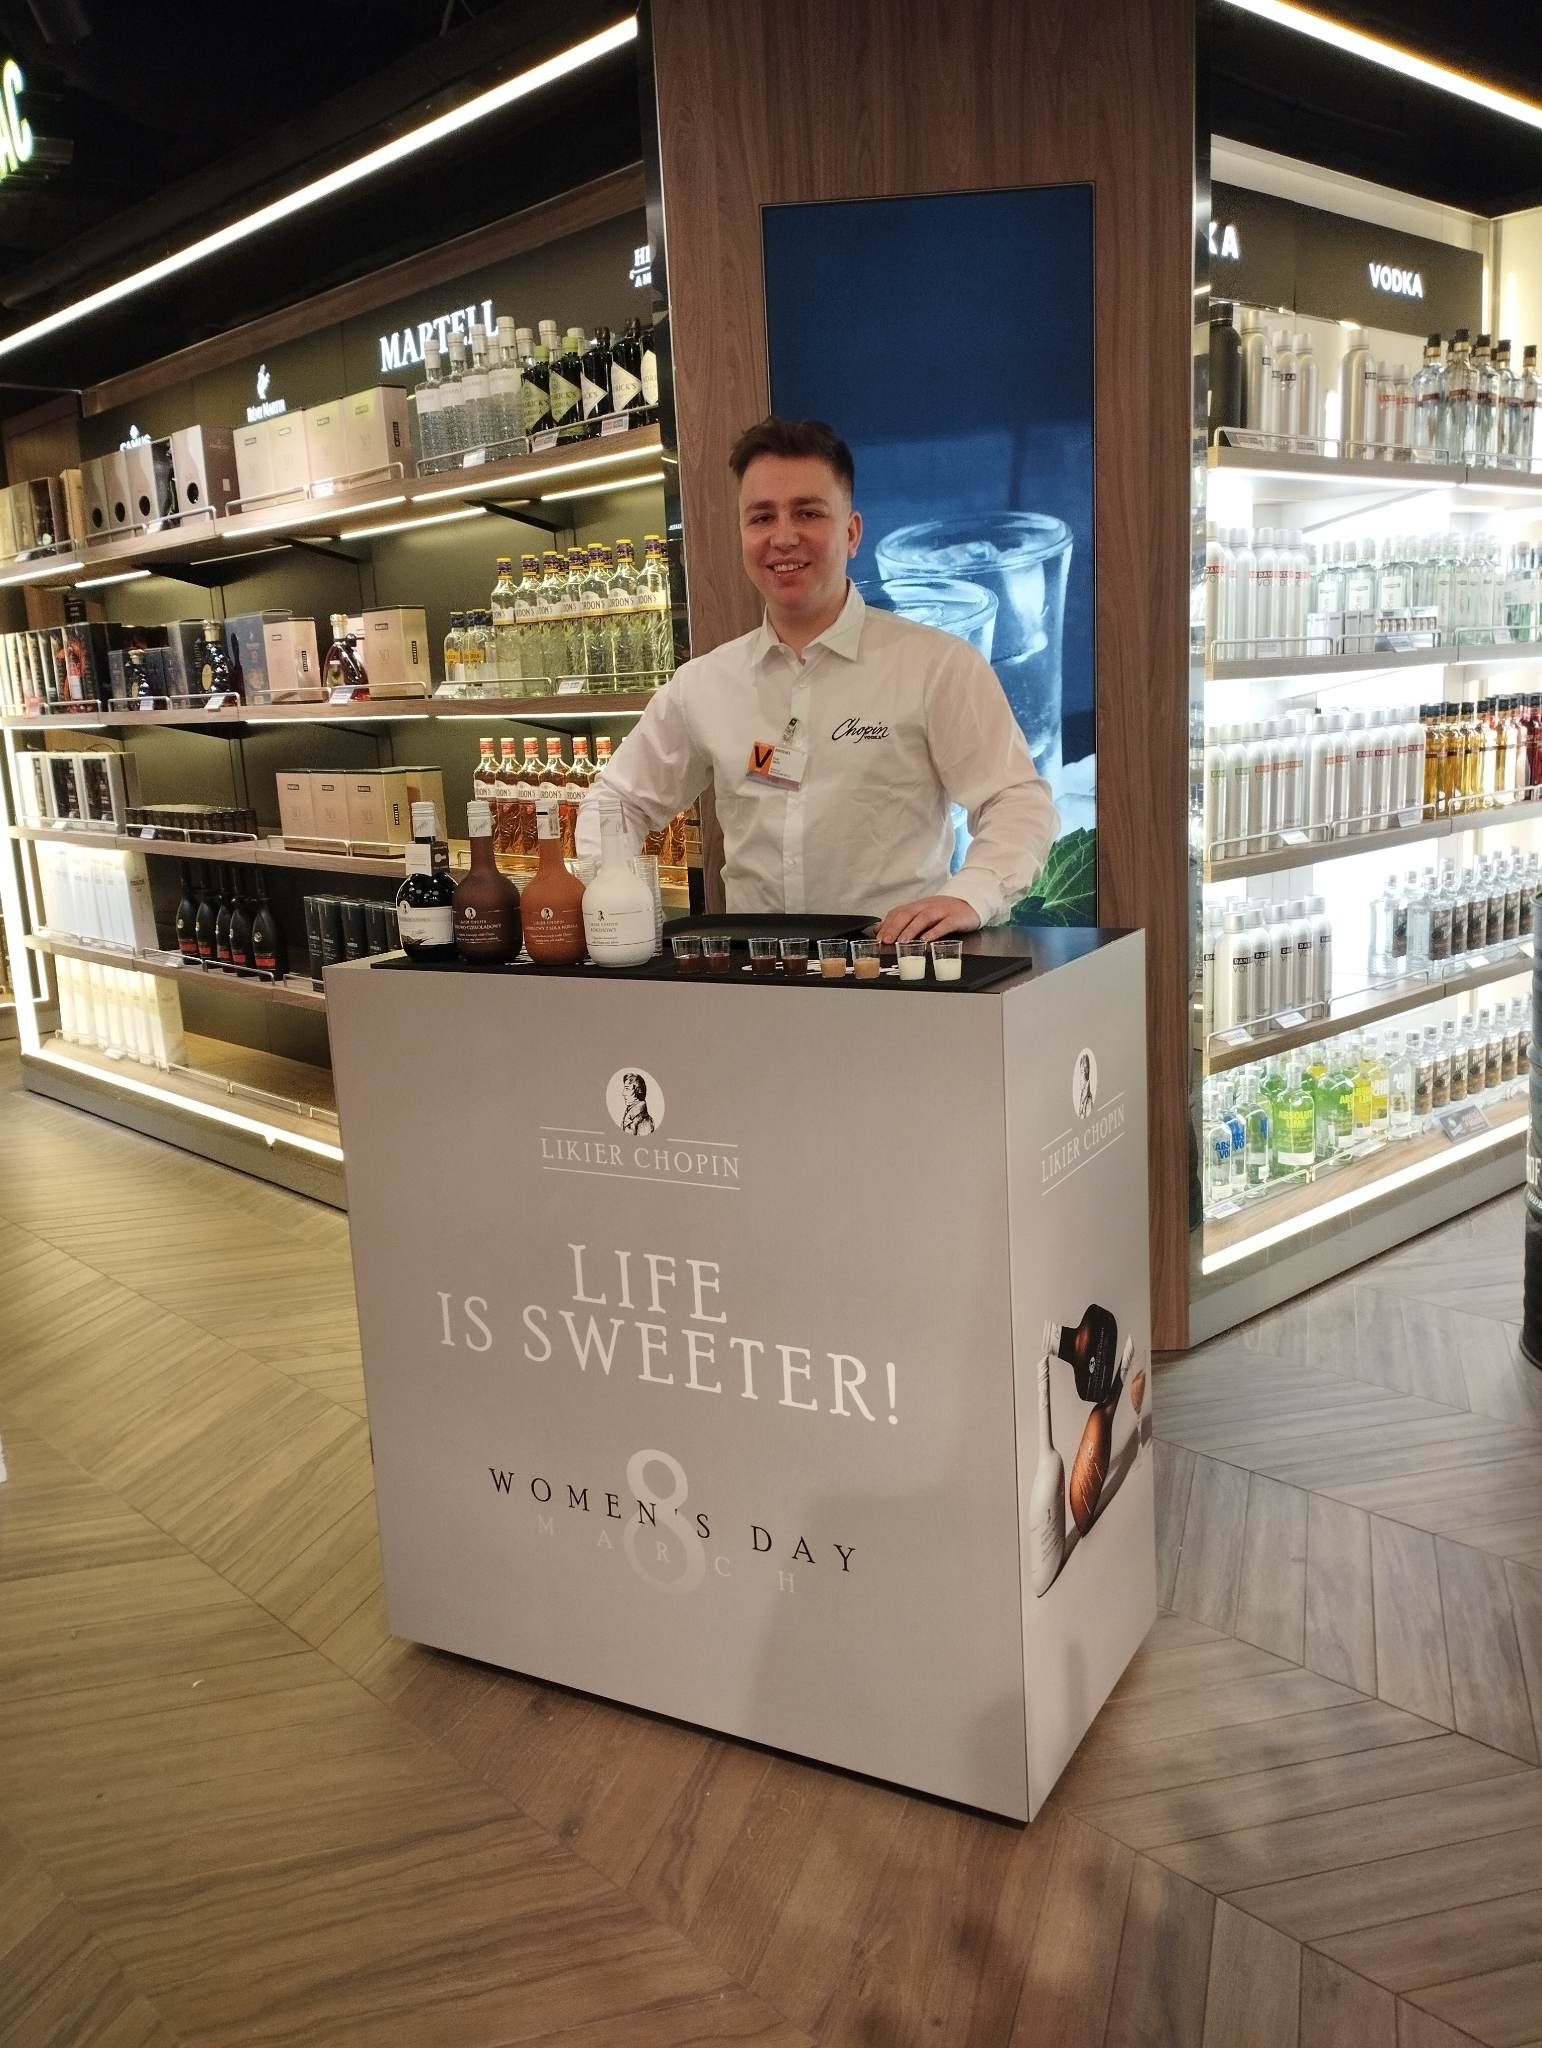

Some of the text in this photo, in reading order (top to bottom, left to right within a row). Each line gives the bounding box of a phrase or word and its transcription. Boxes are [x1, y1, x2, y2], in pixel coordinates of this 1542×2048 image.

[1368, 262, 1424, 299] VODKA
[379, 299, 499, 372] MARTELL
[754, 745, 773, 768] V
[831, 717, 890, 744] Chopin
[540, 1137, 740, 1178] LIKIER CHOPIN
[1041, 1104, 1125, 1184] LIKIER CHOPIN
[567, 1242, 727, 1324] LIFE
[437, 1291, 898, 1425] IS SWEETER!
[488, 1467, 856, 1573] WOMEN'S DAY
[537, 1513, 796, 1593] MARCH
[624, 1448, 706, 1595] 8
